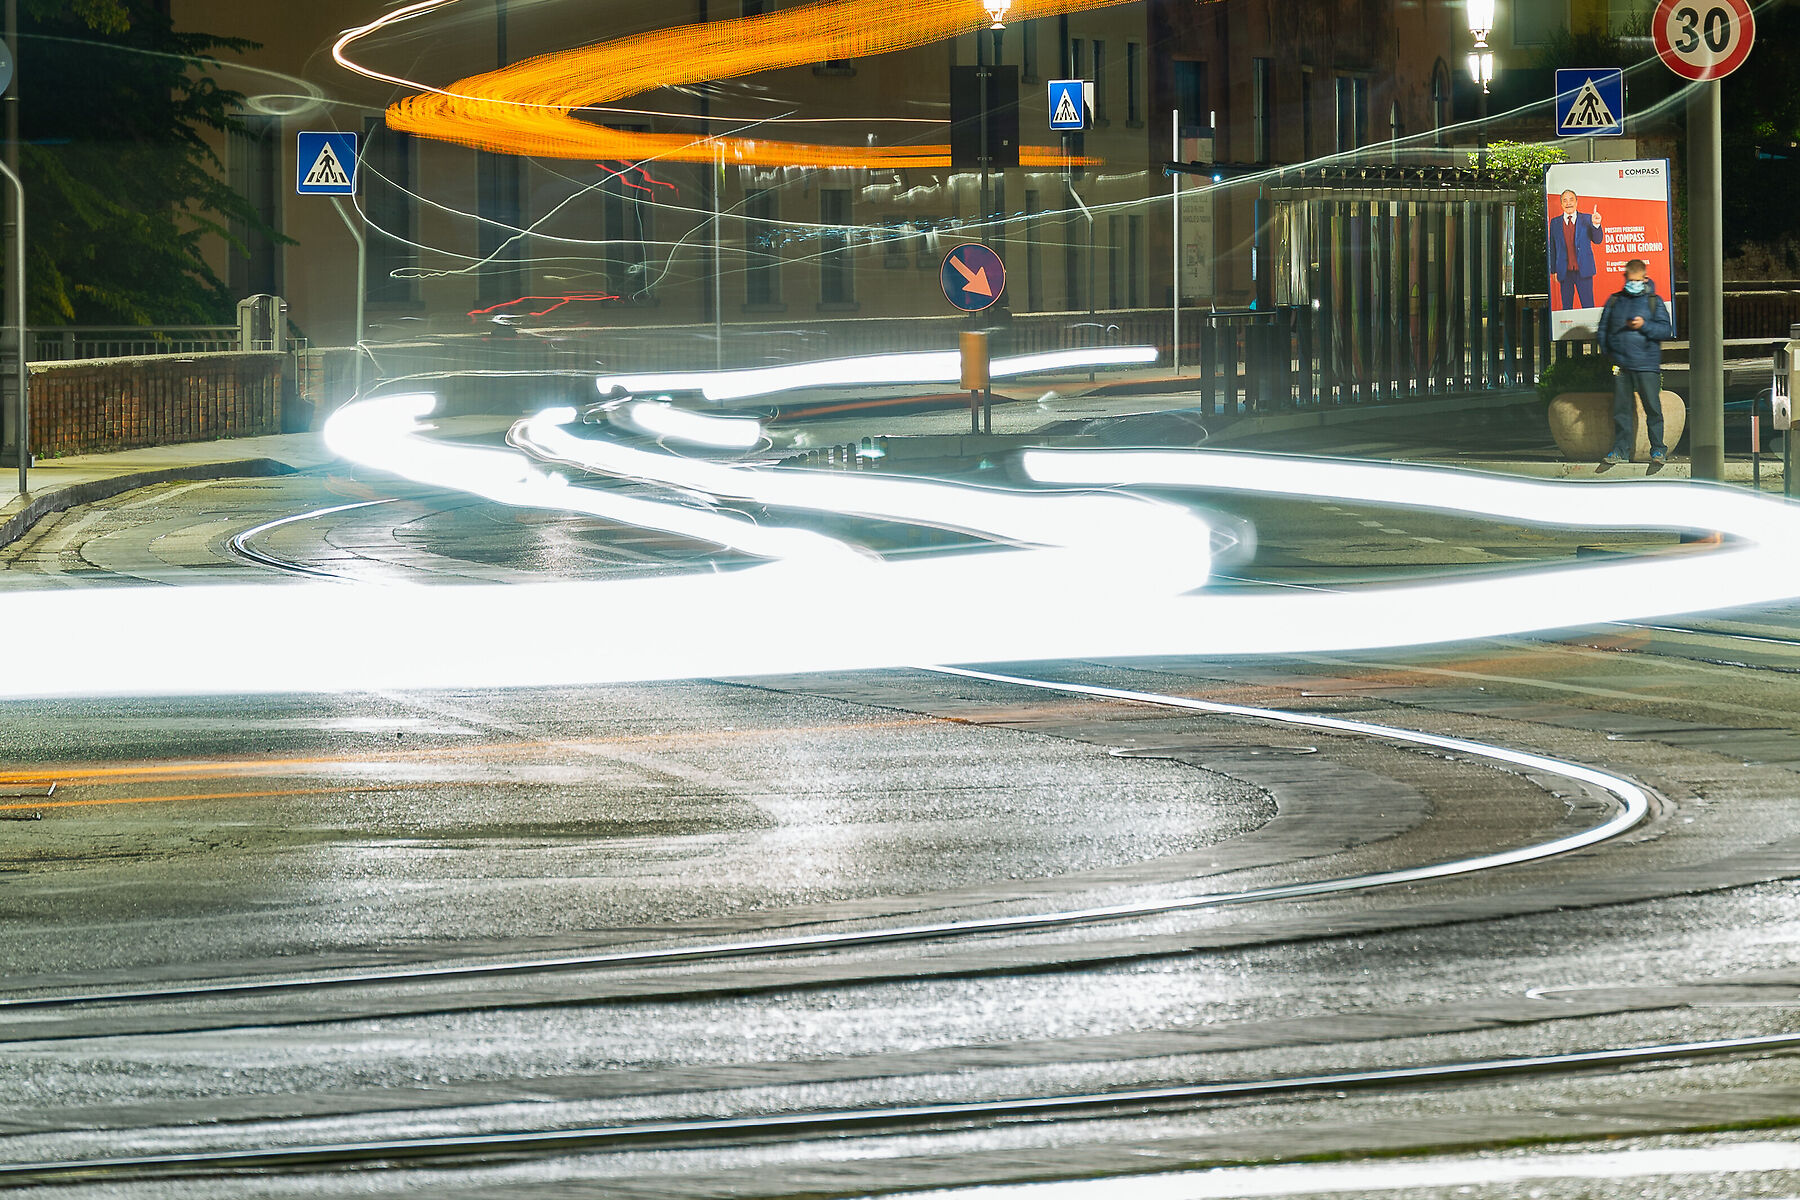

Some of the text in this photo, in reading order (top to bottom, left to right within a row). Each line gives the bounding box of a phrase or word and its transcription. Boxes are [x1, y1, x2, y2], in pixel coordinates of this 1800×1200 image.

[1675, 7, 1731, 53] 30
[1625, 167, 1660, 176] COMPASS
[1605, 233, 1645, 243] DA COMPASS
[1605, 244, 1625, 253] BASTA
[1626, 243, 1637, 252] UN
